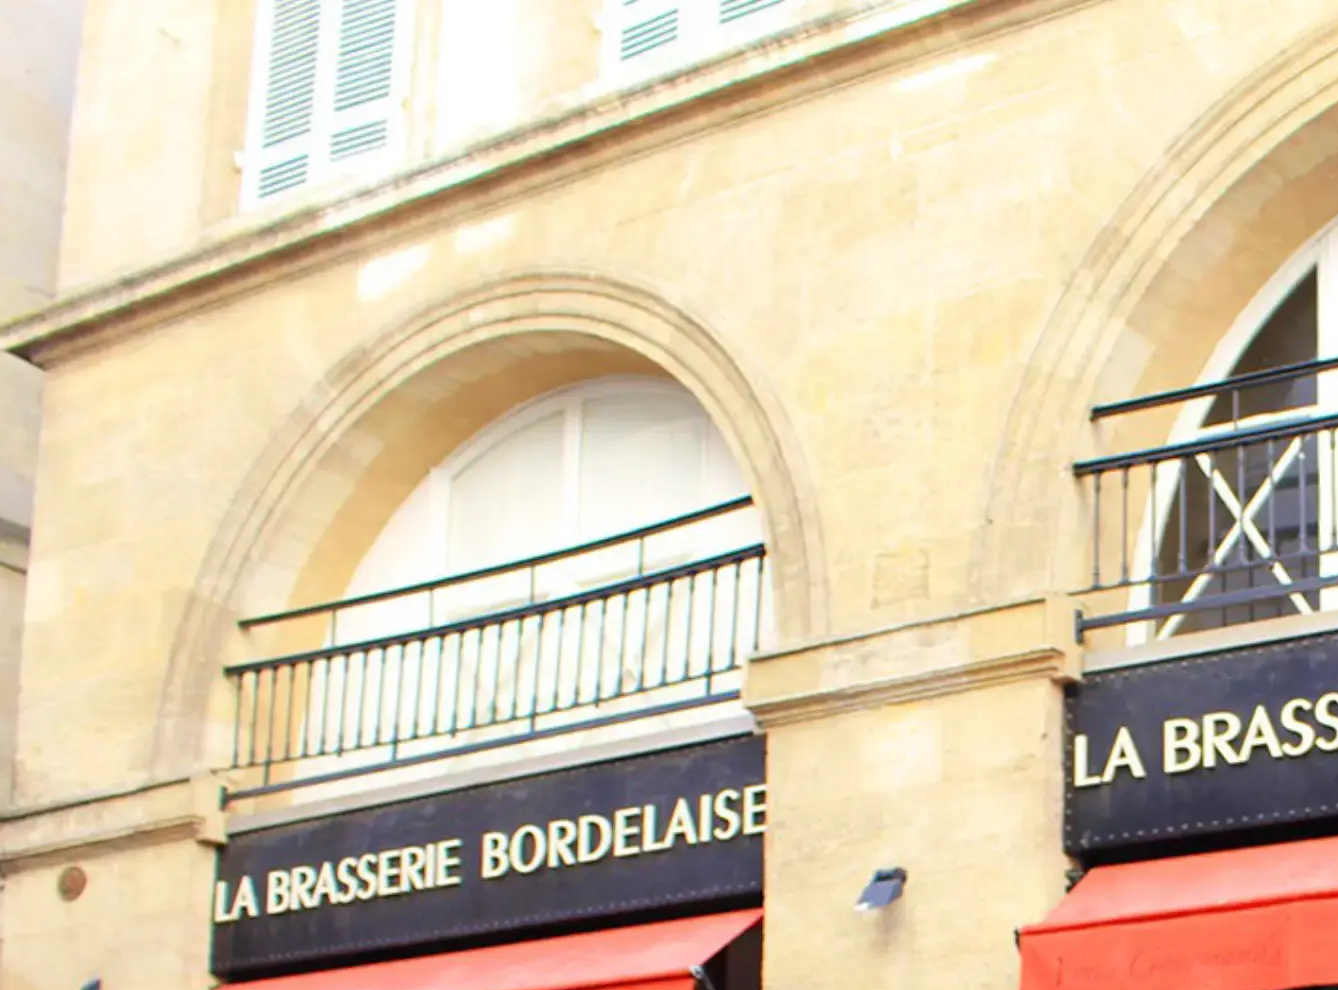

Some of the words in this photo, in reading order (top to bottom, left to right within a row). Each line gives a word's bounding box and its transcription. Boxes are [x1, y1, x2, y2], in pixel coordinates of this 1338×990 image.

[1073, 726, 1146, 788] LA
[214, 874, 260, 923] LA
[266, 838, 463, 915] BRASSERIE
[481, 784, 768, 879] BORDELAISE
